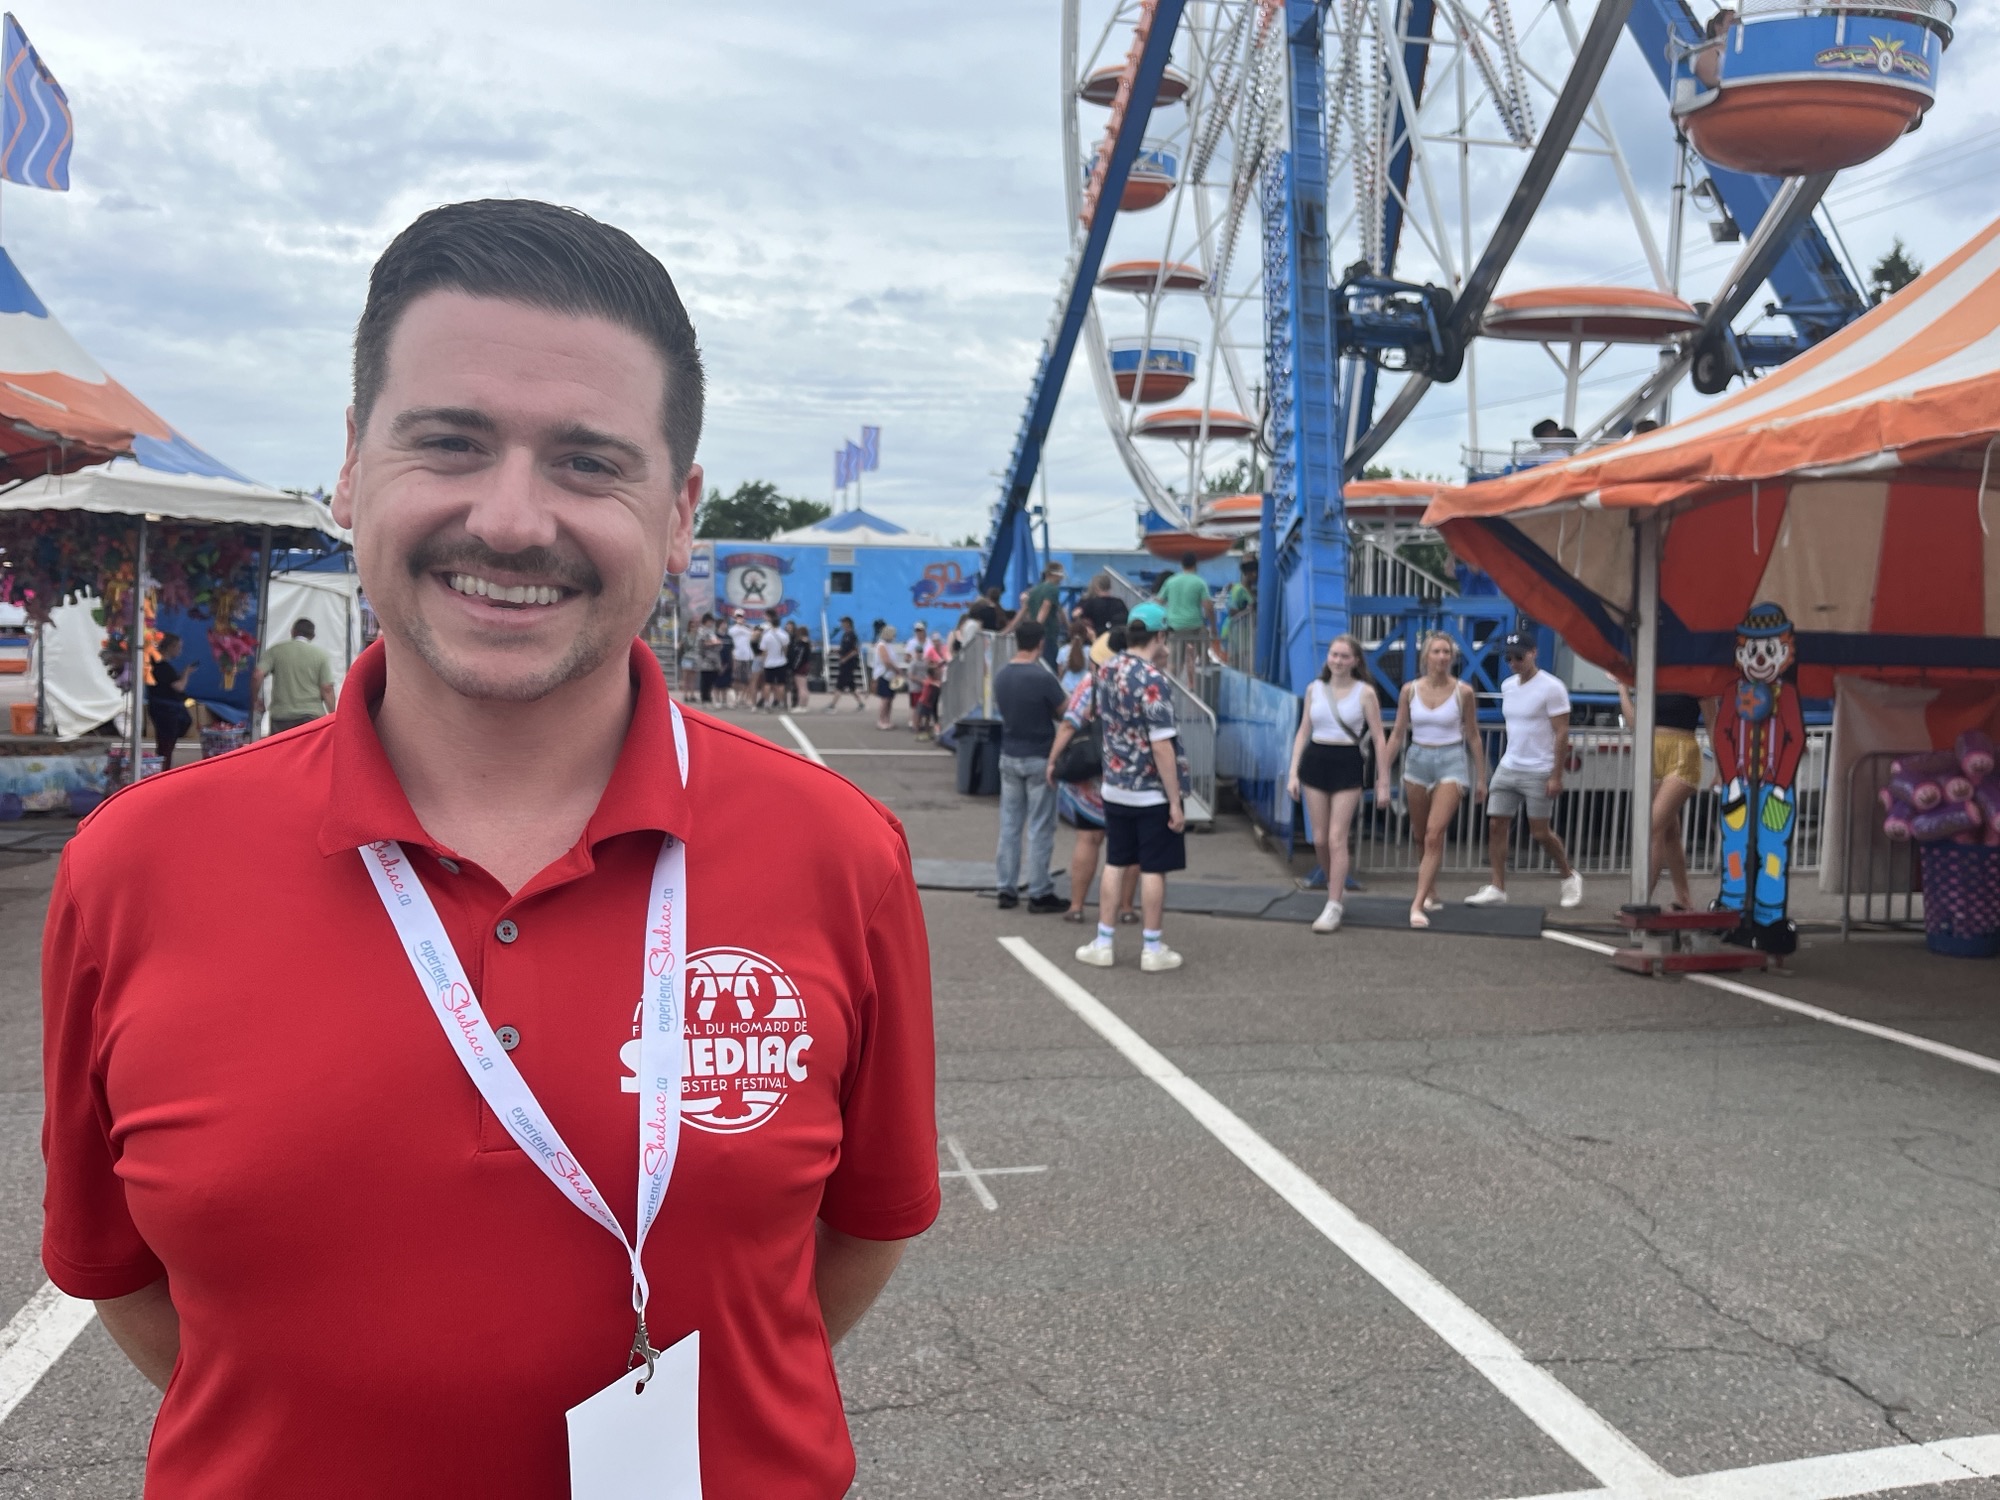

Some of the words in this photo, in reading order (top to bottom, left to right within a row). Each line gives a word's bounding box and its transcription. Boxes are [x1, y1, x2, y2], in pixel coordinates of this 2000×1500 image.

[706, 1022, 725, 1035] DU
[730, 1020, 790, 1034] HOMARD
[794, 1020, 808, 1033] DE
[682, 1078, 728, 1092] BSTER
[735, 1077, 788, 1090] FESTIVAL
